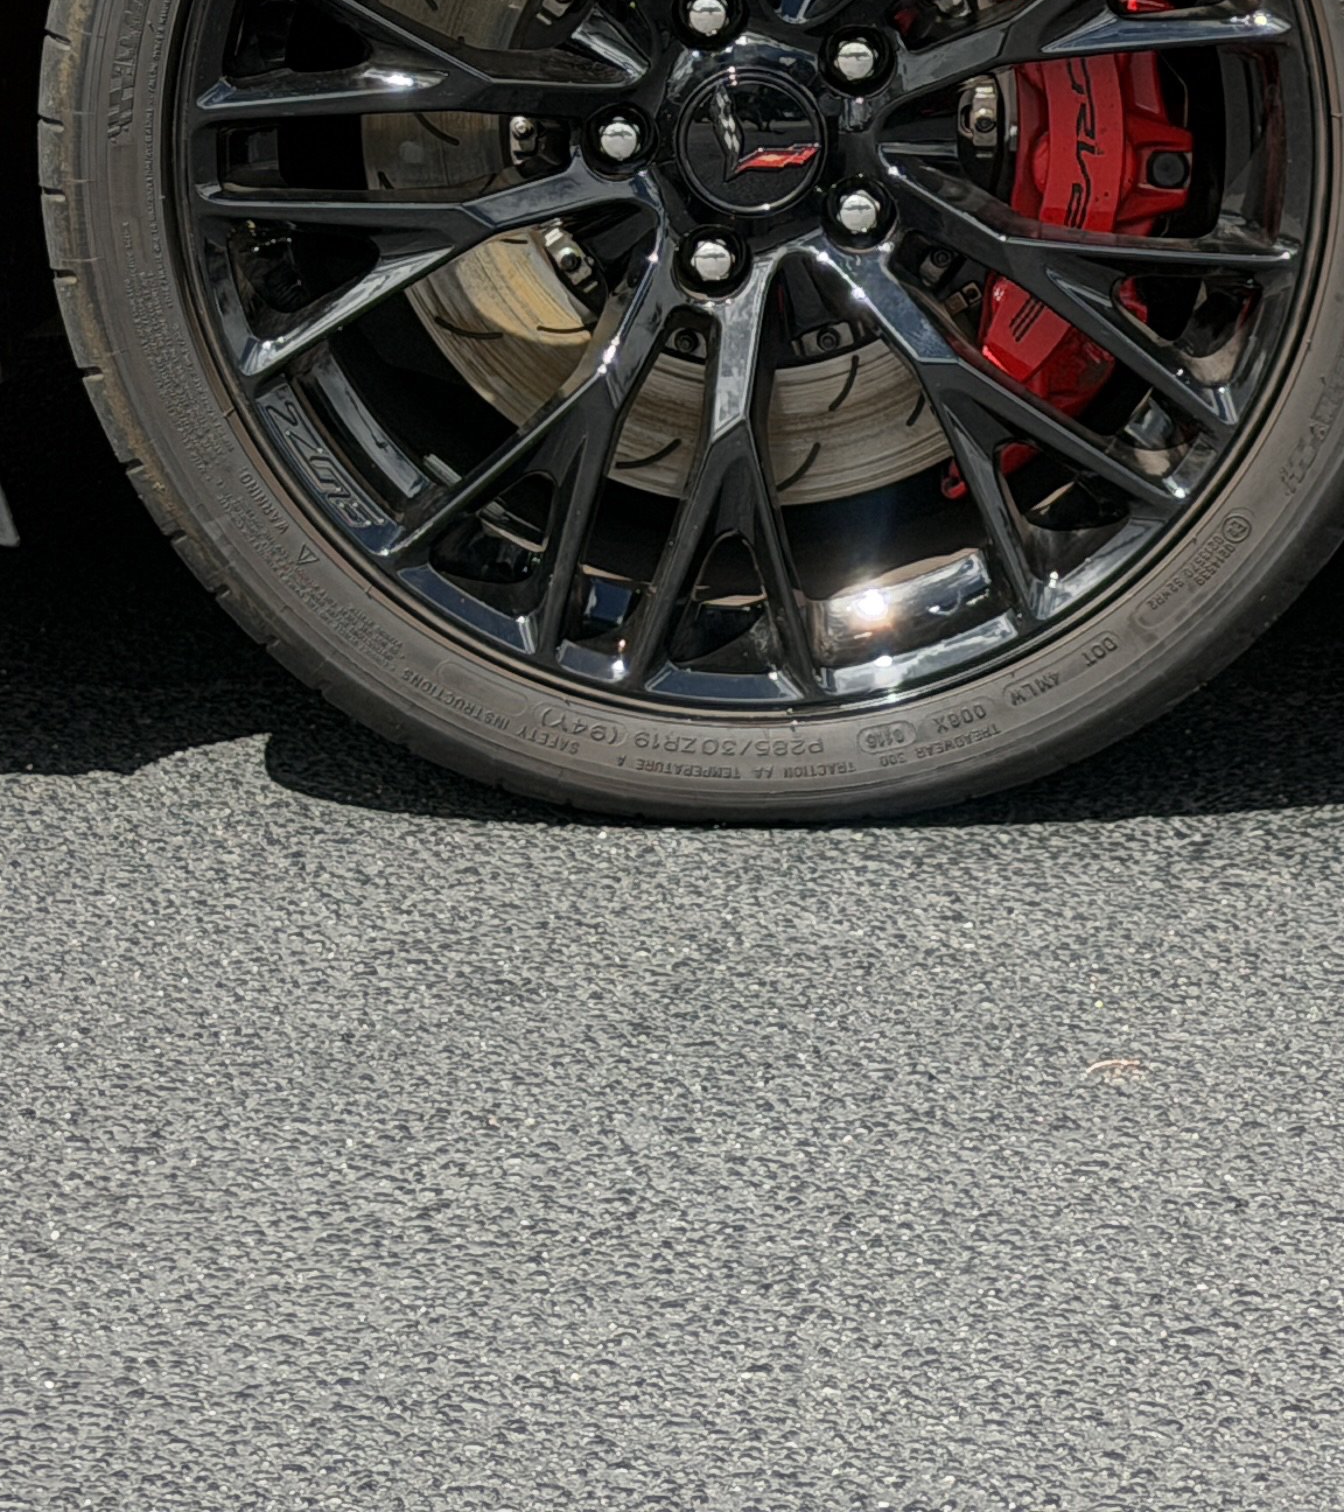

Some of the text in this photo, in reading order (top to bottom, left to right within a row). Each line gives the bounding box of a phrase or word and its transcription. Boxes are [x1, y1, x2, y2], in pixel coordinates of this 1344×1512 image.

[1079, 634, 1119, 668] DOT
[399, 665, 581, 756] SAFETY INSTRUCTIONS
[538, 705, 620, 746] (94Y)
[913, 722, 1001, 759] TREADWEAR
[615, 752, 627, 767] A
[634, 756, 740, 780] TEMPERATURE
[753, 766, 773, 779] AA
[782, 759, 857, 779] TRACTION
